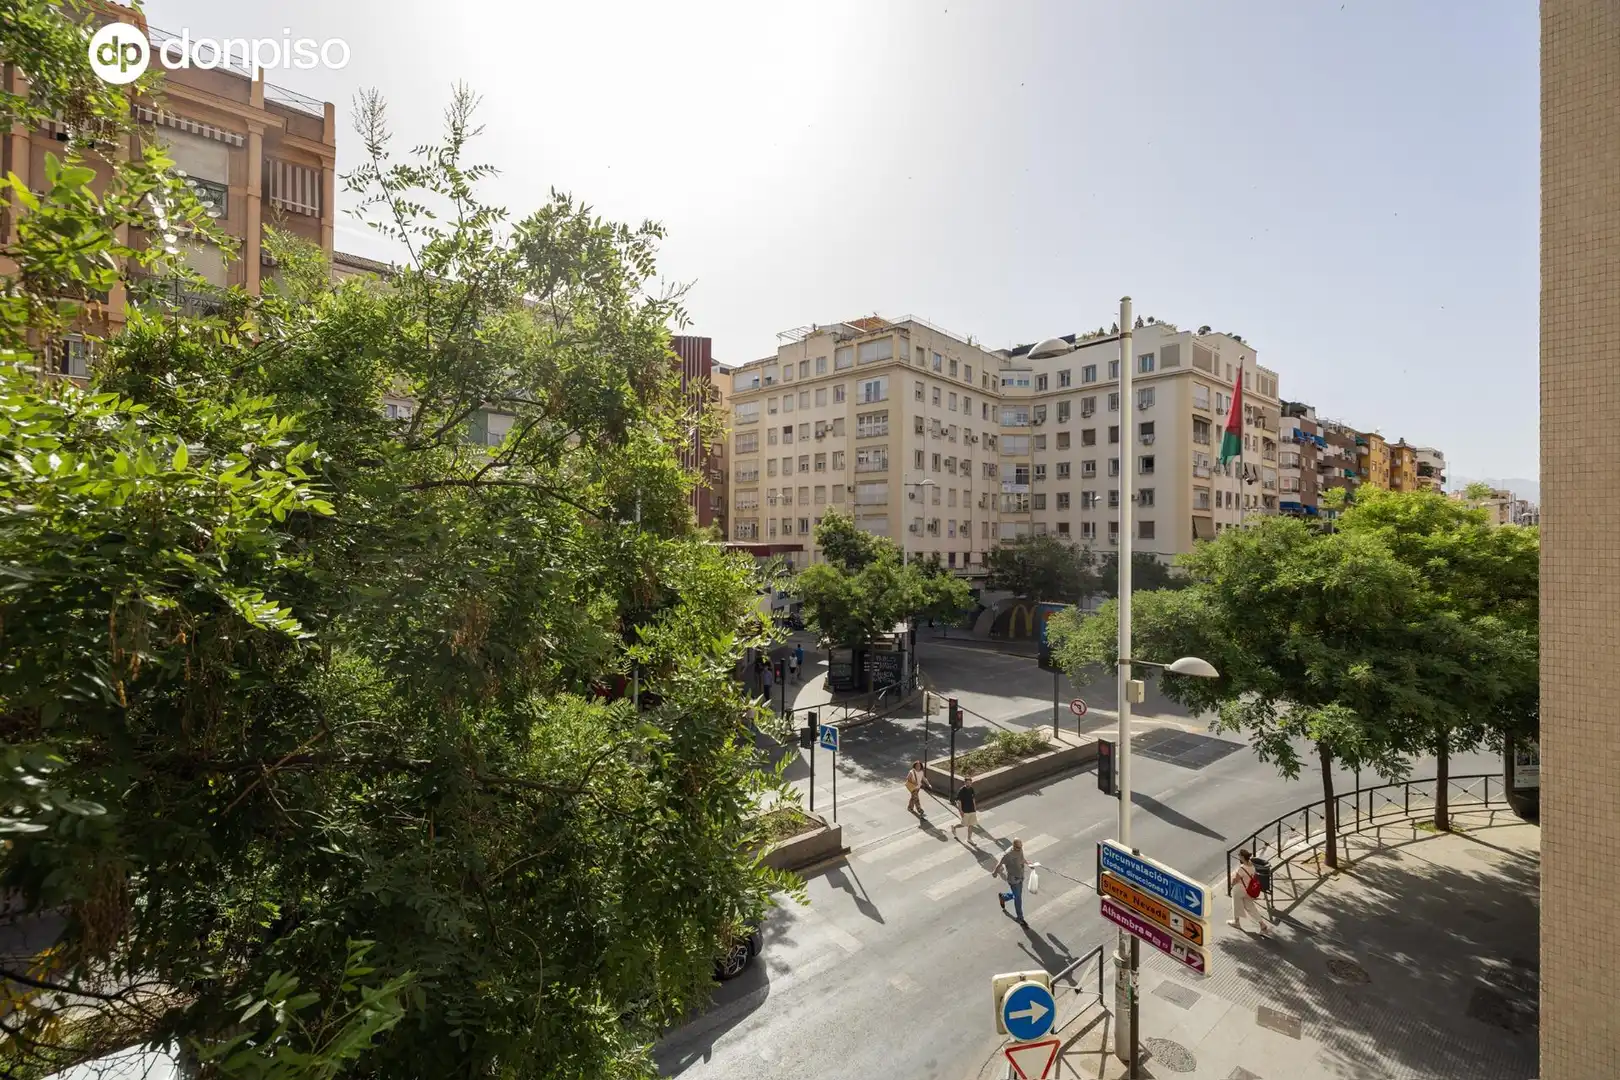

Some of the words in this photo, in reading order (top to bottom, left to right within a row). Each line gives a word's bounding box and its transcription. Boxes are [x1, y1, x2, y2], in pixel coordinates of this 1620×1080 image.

[1103, 847, 1169, 886] Circunvalación
[1103, 879, 1128, 899] Sierra
[1133, 896, 1167, 920] Nevada
[1102, 904, 1145, 935] Alhambra
